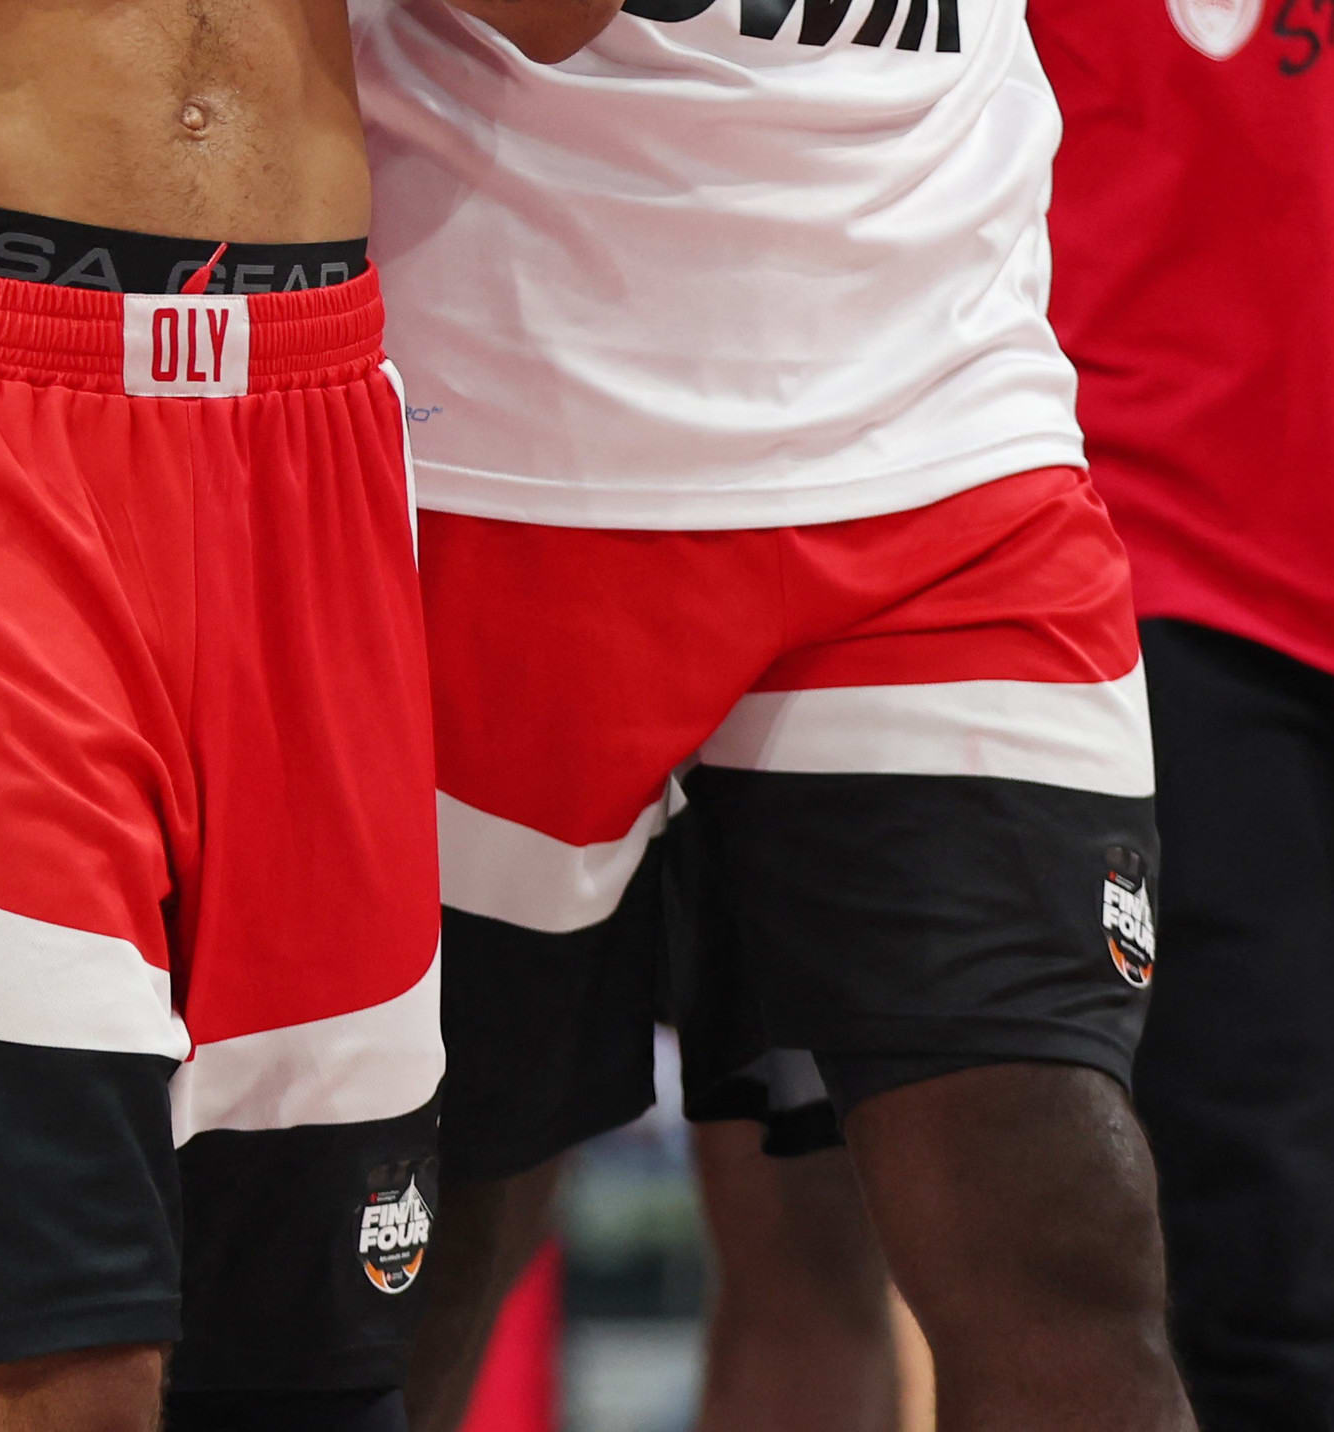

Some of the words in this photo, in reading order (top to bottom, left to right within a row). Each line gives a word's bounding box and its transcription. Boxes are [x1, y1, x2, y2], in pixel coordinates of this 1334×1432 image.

[151, 307, 230, 383] OLY
[1102, 901, 1156, 963] FOUR
[358, 1219, 431, 1254] FOUR
[361, 1197, 429, 1229] FINAL
